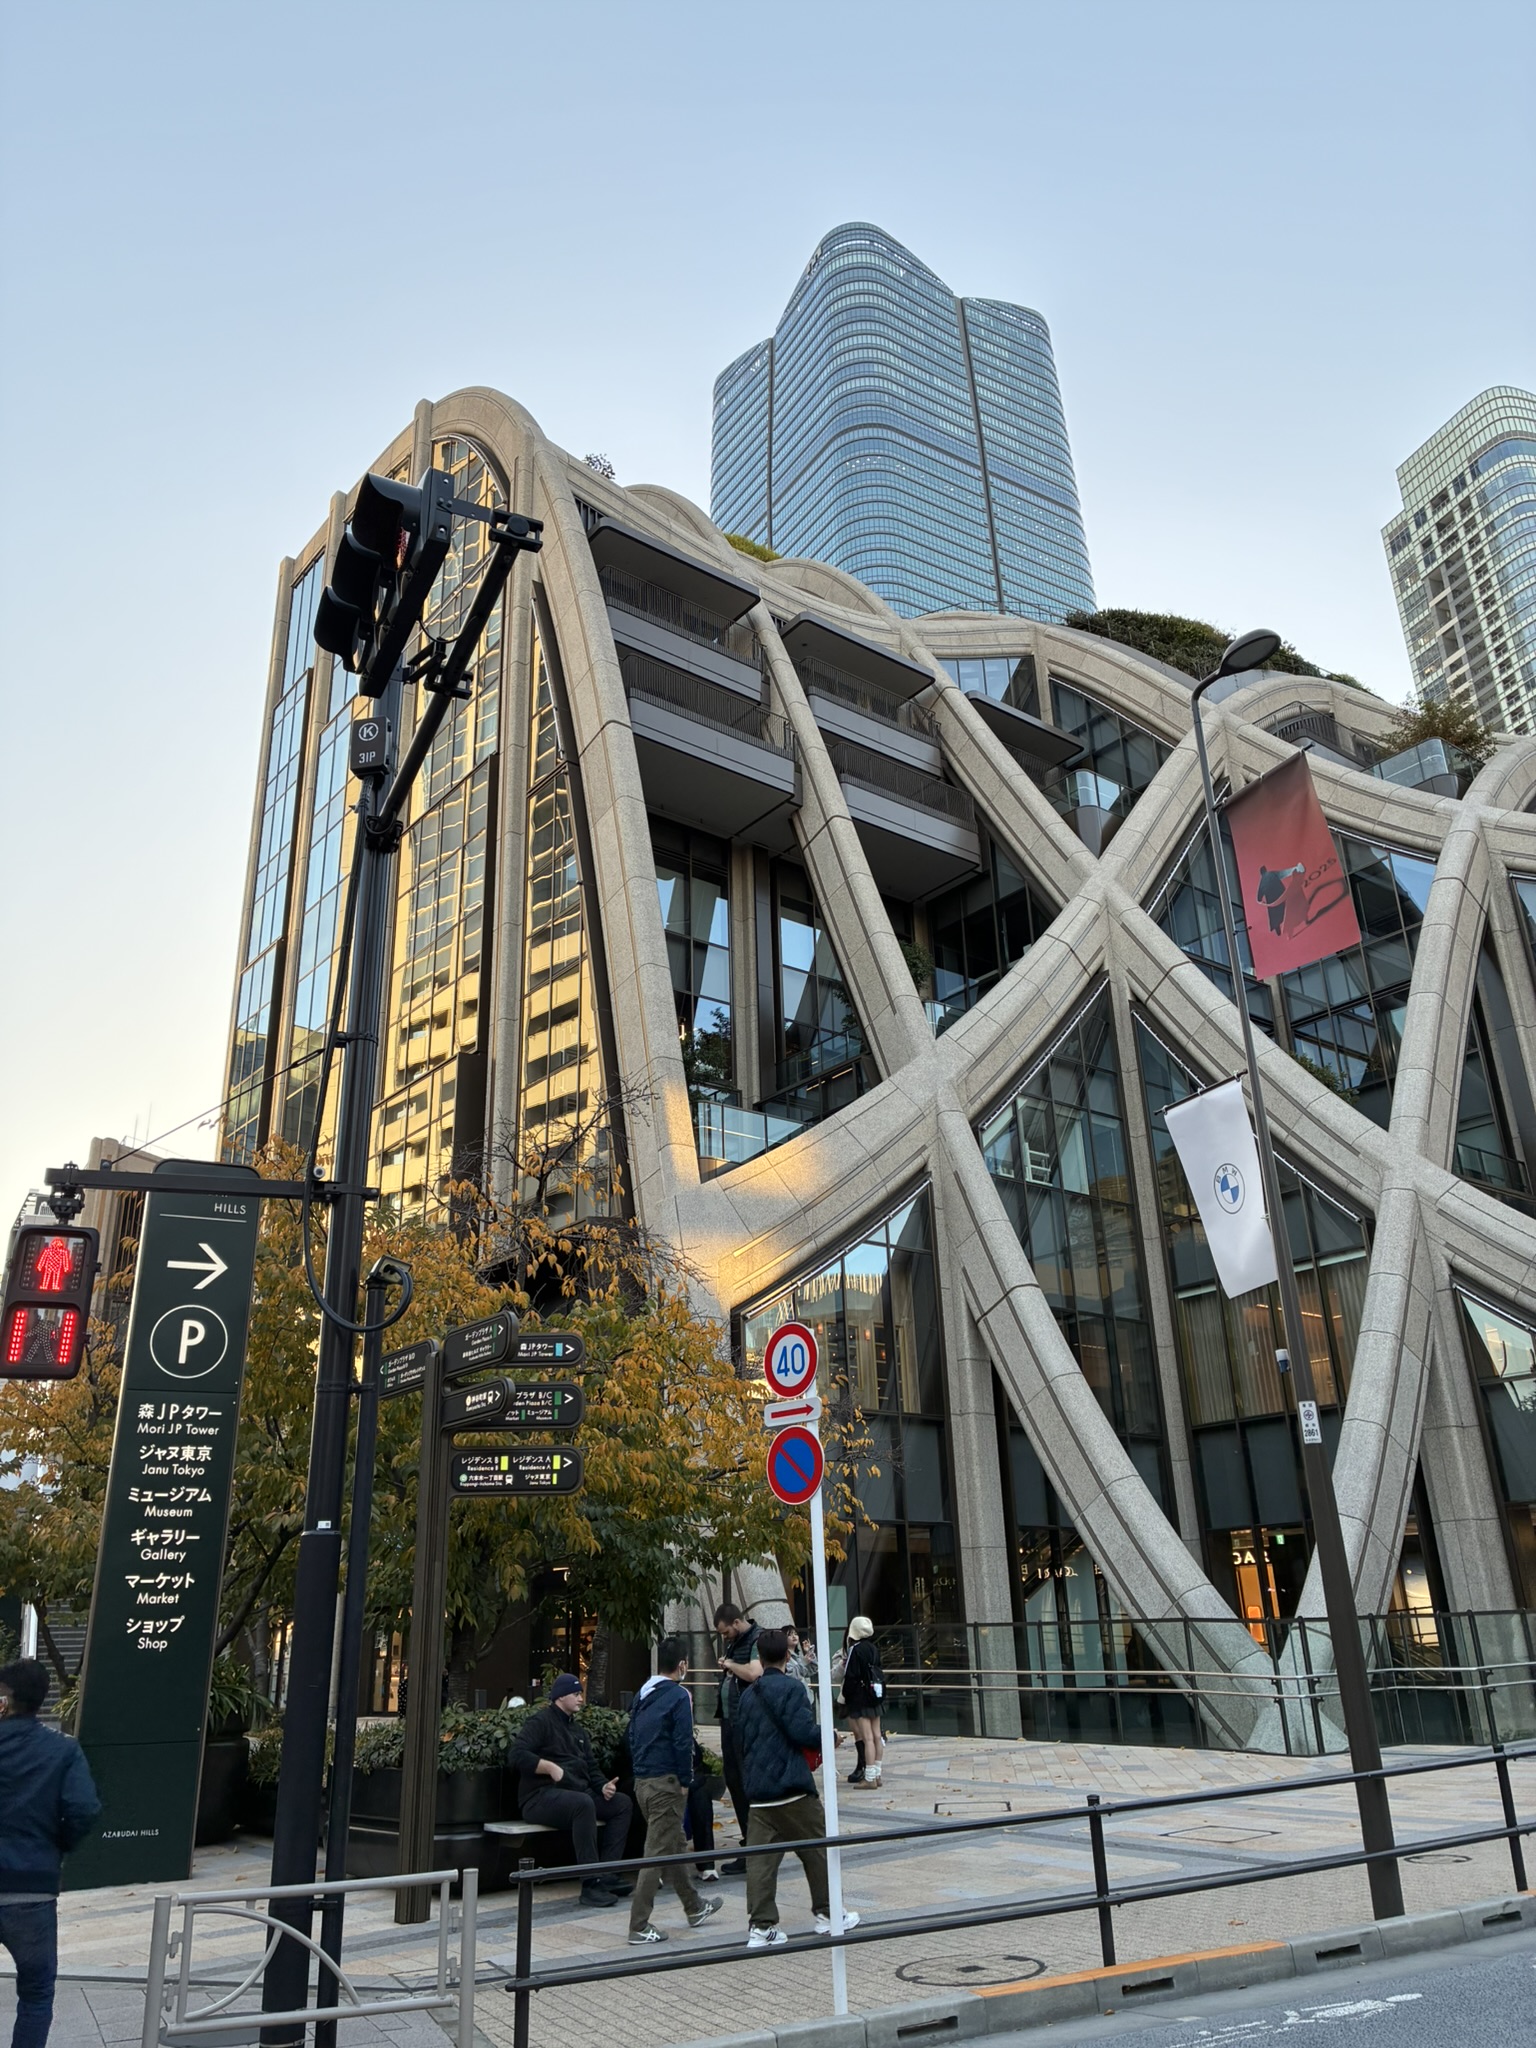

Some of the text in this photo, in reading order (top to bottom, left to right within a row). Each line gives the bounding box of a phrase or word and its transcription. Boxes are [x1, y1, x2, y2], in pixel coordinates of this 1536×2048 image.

[1215, 1166, 1238, 1184] BMW
[213, 1202, 247, 1215] HILLS
[178, 1319, 206, 1364] P
[776, 1343, 805, 1377] 40
[538, 1391, 553, 1399] B/C
[137, 1403, 222, 1420] 森JPタワー
[137, 1423, 219, 1436] Mori JP Tower
[138, 1445, 213, 1462] ジャヌ東京
[461, 1456, 499, 1464] レジデンス B
[512, 1455, 551, 1464] レジデンス A
[141, 1463, 206, 1478] Janu Tokyo
[127, 1486, 212, 1503] ミュージアム
[144, 1506, 193, 1517] Museum
[130, 1529, 201, 1546] ギャラリー
[140, 1549, 187, 1563] Gallery
[124, 1572, 196, 1589] マーケット
[136, 1592, 180, 1604] Market
[125, 1615, 186, 1634] ショップ
[137, 1637, 168, 1652] Shop
[102, 1830, 138, 1838] AZABUDAI
